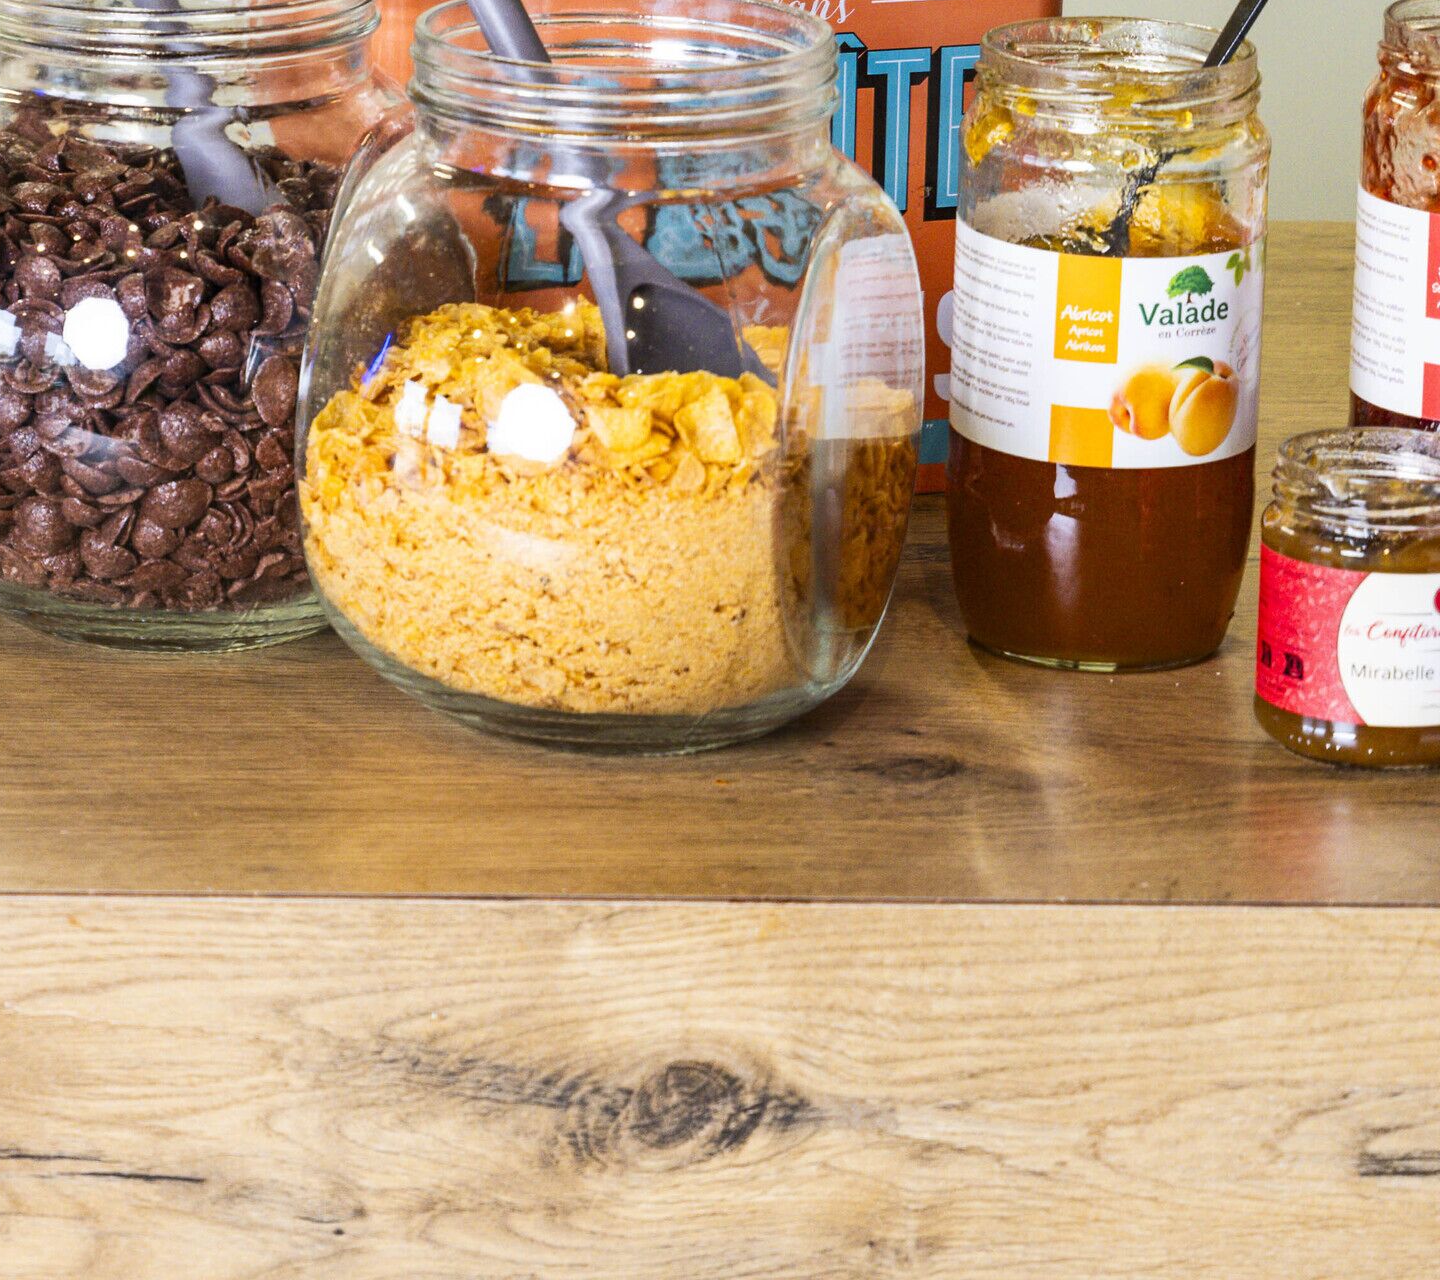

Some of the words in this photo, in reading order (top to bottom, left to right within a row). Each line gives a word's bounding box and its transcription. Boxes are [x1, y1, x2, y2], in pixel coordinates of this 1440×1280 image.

[1060, 304, 1114, 324] Abricot
[1138, 298, 1229, 327] Valade
[1068, 324, 1104, 339] Apricot
[1158, 328, 1172, 339] en
[1175, 325, 1217, 338] Corrèze
[1064, 339, 1107, 354] Abrikoos
[1350, 663, 1435, 680] Mirabelle
